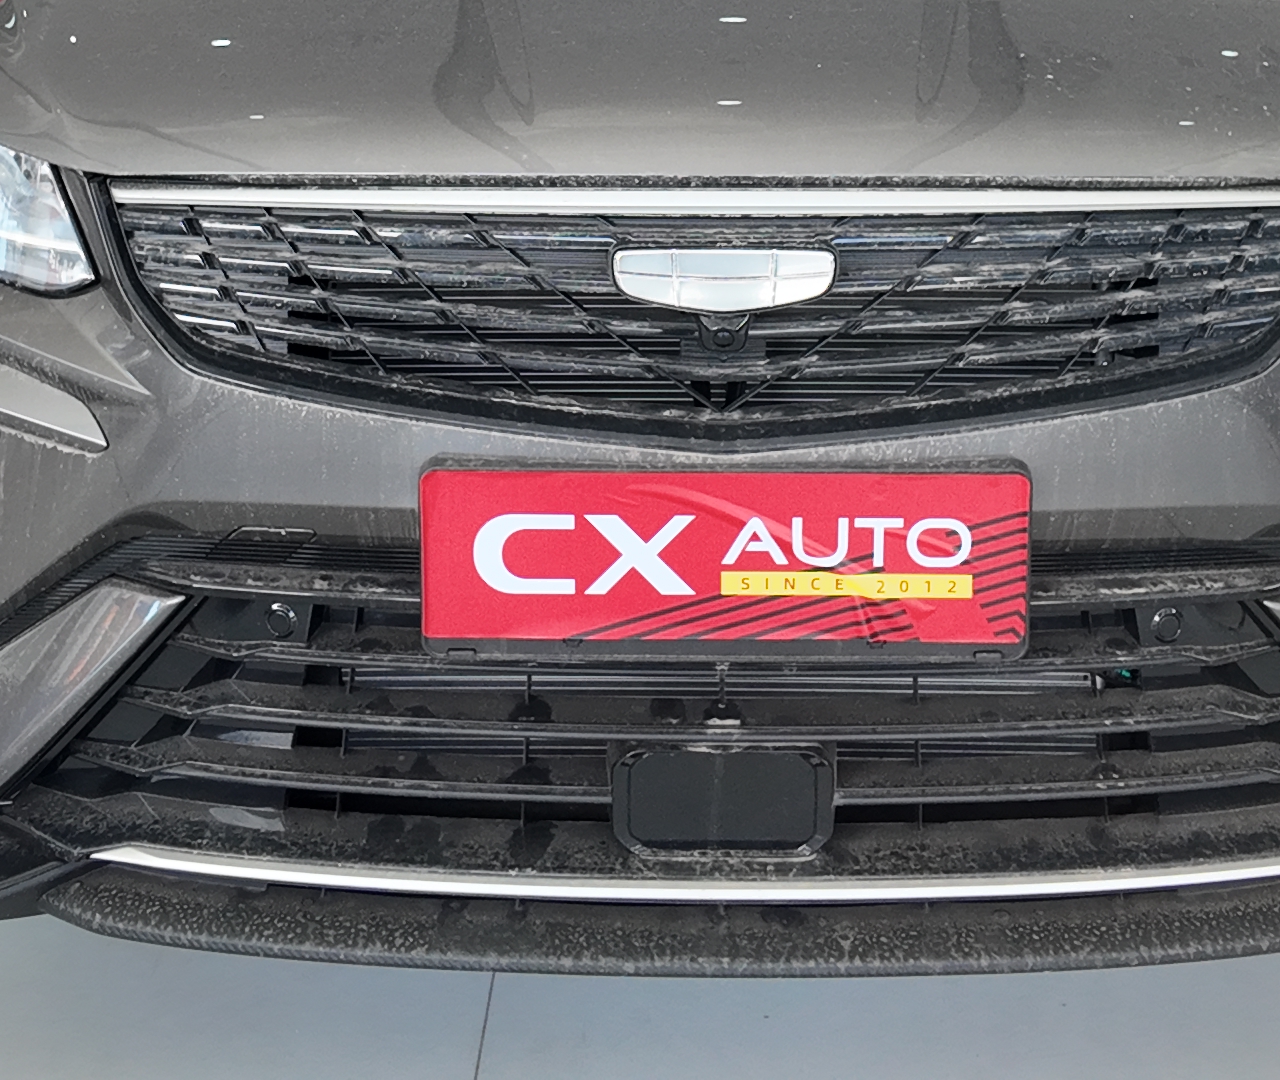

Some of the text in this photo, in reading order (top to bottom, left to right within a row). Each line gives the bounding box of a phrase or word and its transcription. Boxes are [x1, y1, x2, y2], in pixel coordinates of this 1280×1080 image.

[473, 514, 973, 596] CX AUTO
[740, 578, 957, 594] SINCE 2012
